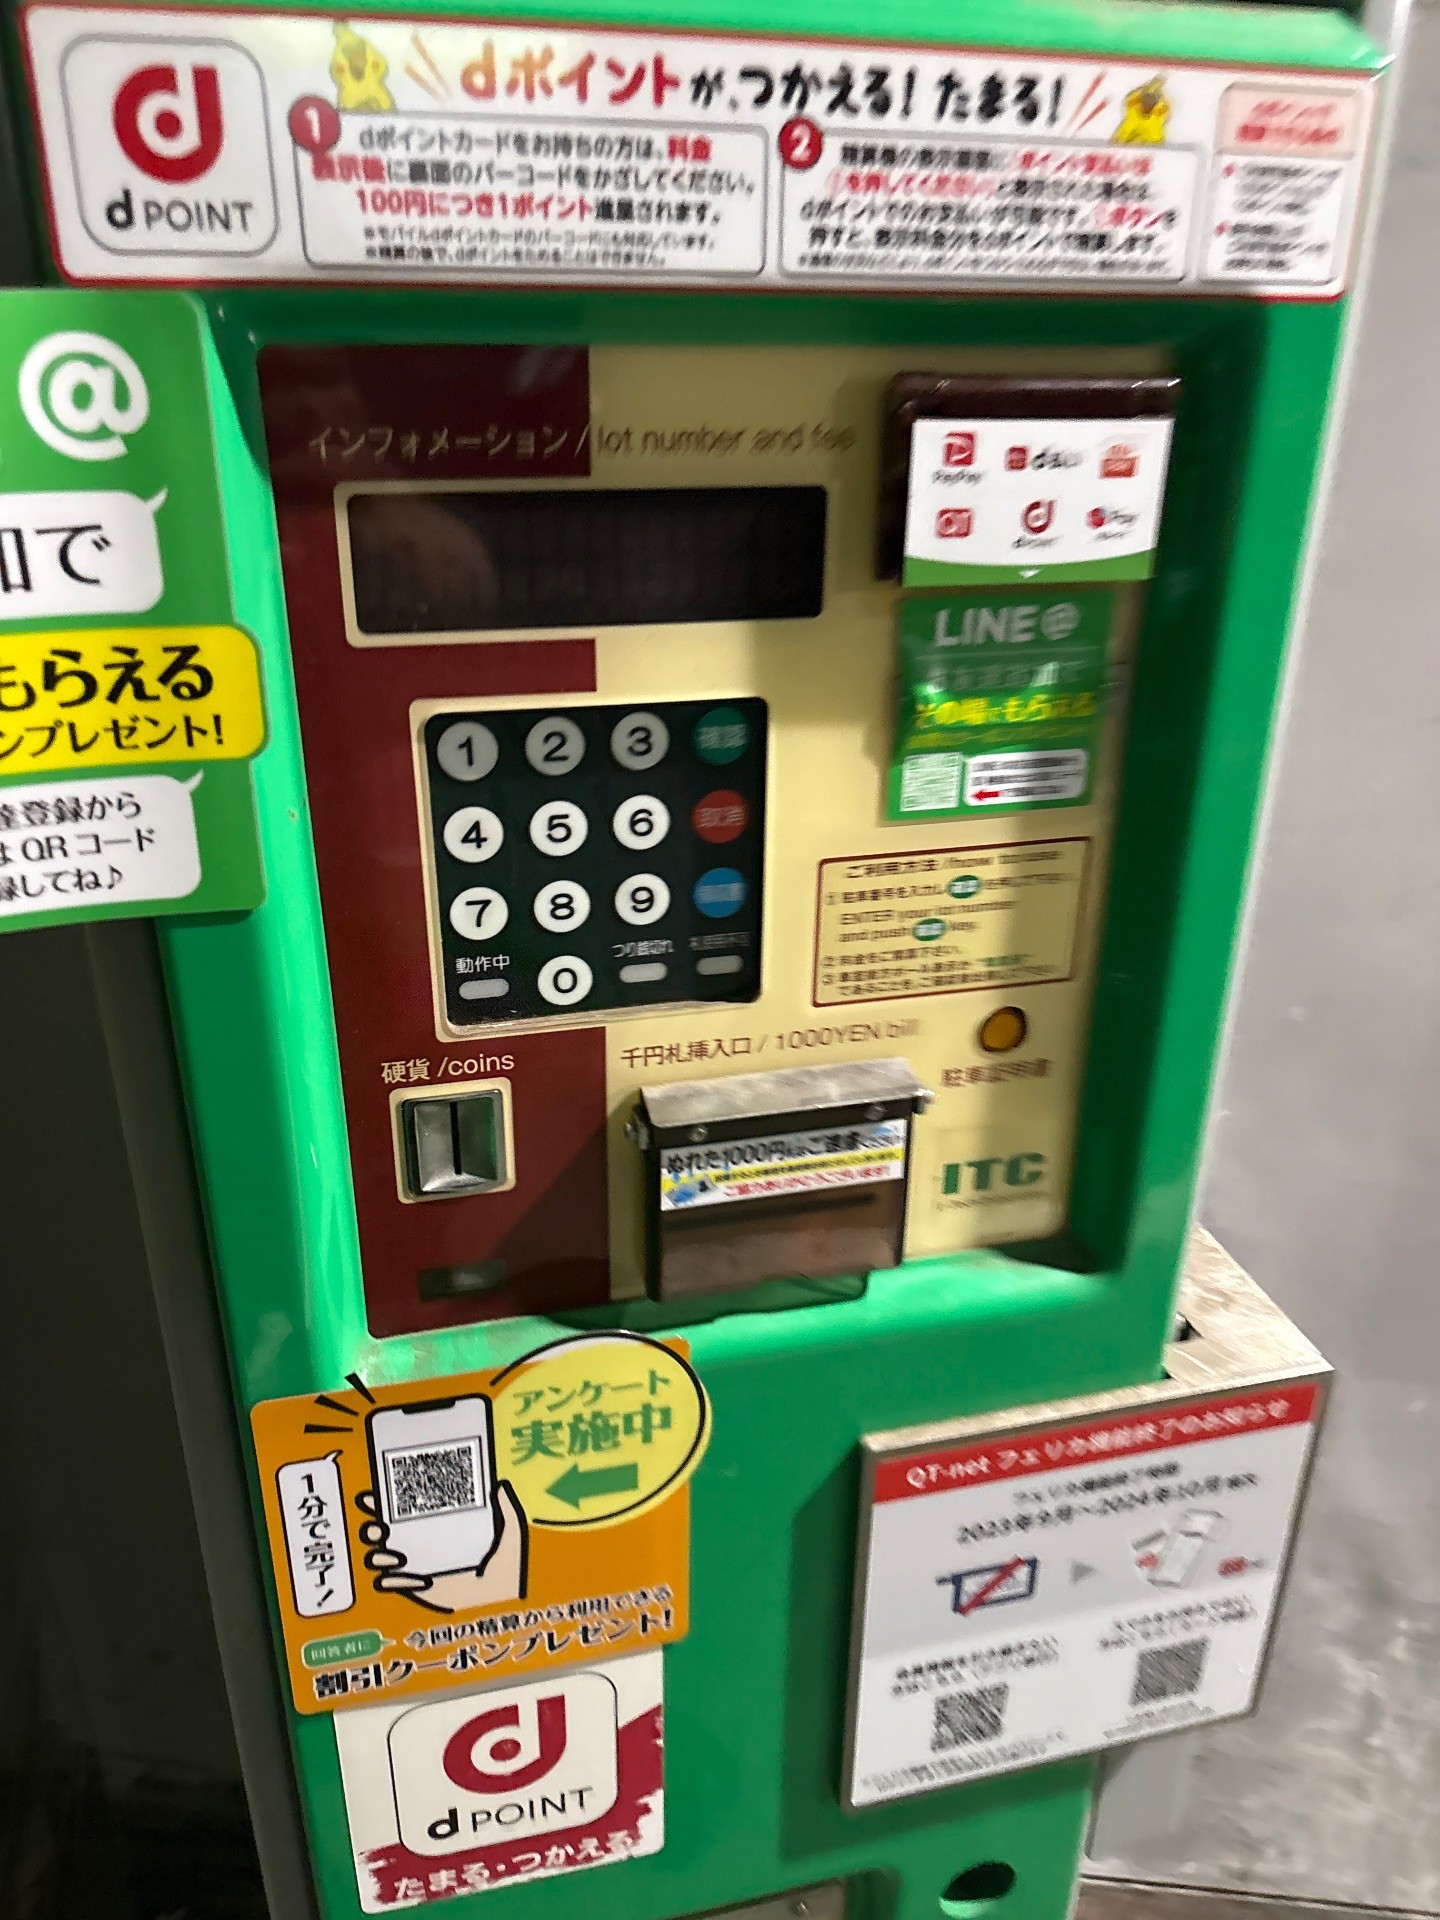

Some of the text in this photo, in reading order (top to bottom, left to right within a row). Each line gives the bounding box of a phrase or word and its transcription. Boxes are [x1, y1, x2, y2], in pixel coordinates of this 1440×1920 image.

[105, 188, 254, 234] d POINT
[458, 736, 474, 766] 1
[543, 731, 569, 762] 2
[627, 726, 652, 756] 3
[461, 821, 488, 848] 4
[547, 814, 572, 843] 5
[629, 808, 653, 837] 6
[465, 900, 492, 927] 7
[549, 893, 575, 920] 8
[630, 887, 654, 912] 9
[456, 954, 511, 974] 動作中
[553, 967, 578, 994] 0
[621, 1036, 751, 1069] 千円札挿入口
[381, 1058, 431, 1084] 硬貨
[513, 1369, 671, 1416] アンケート
[511, 1402, 672, 1465] 実施中
[427, 1787, 593, 1840] d POINT
